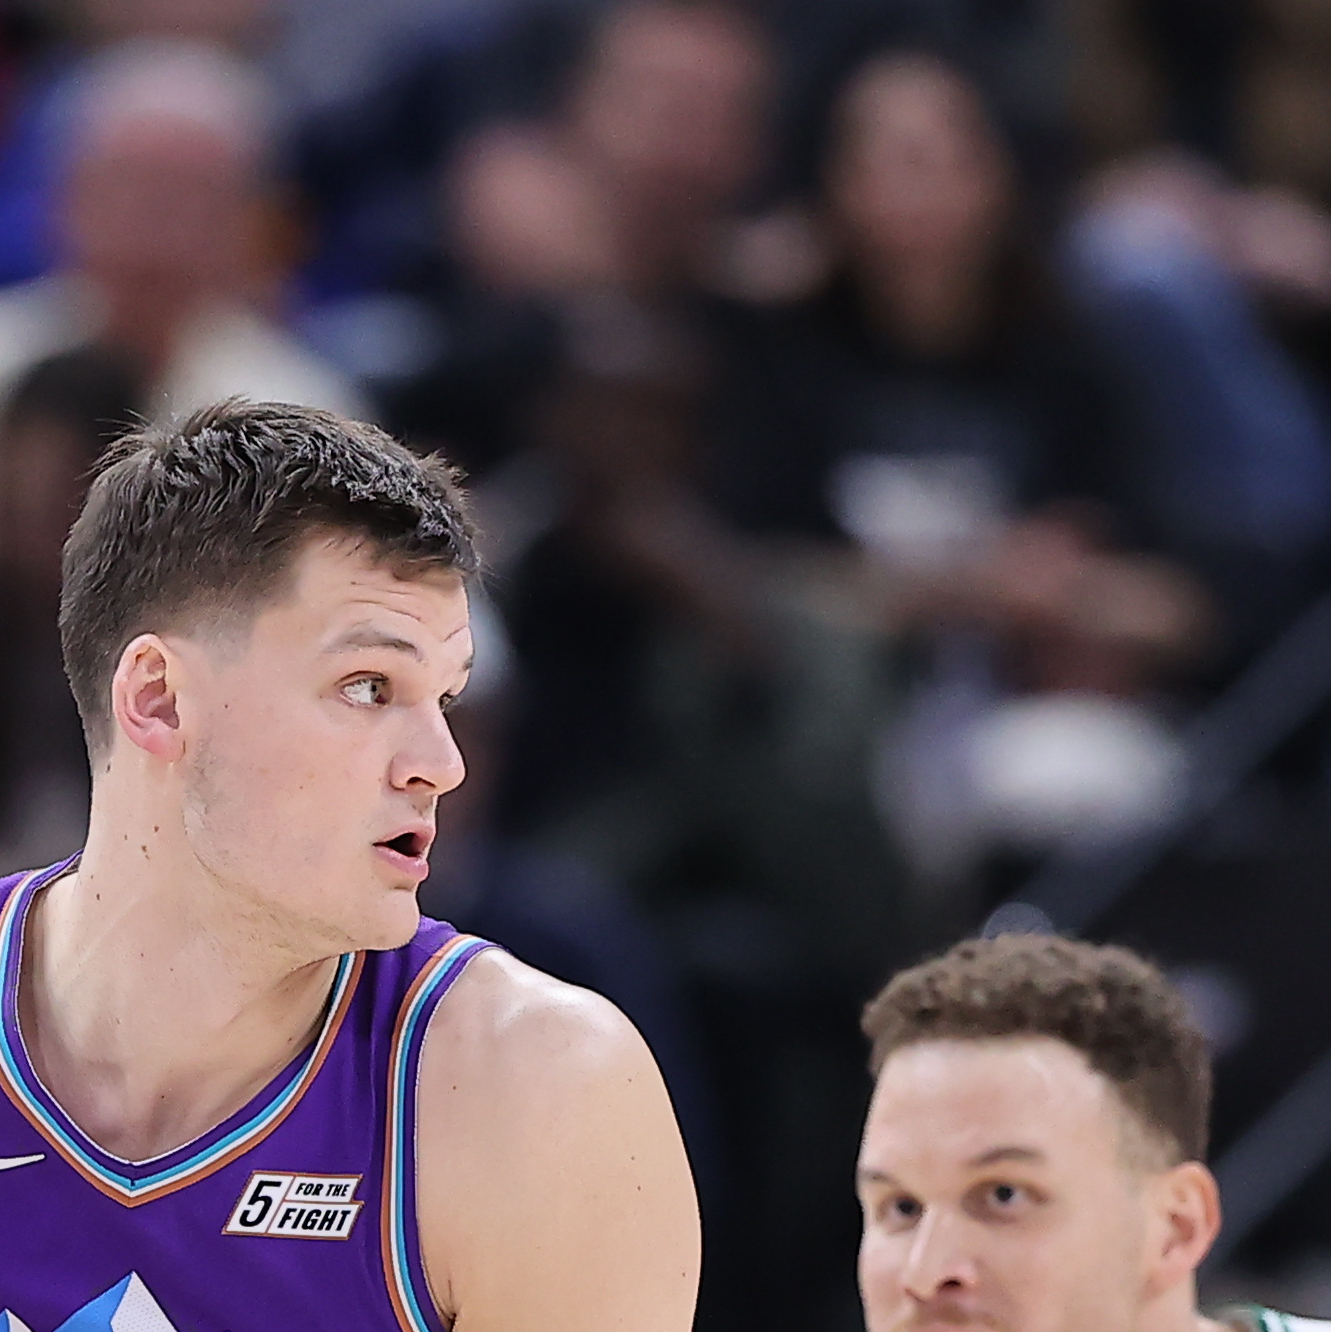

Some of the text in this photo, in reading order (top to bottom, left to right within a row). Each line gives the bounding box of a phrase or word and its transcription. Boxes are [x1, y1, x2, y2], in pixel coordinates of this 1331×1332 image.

[295, 1182, 351, 1197] FOR THE
[238, 1179, 283, 1228] 5
[277, 1207, 352, 1232] FIGHT
